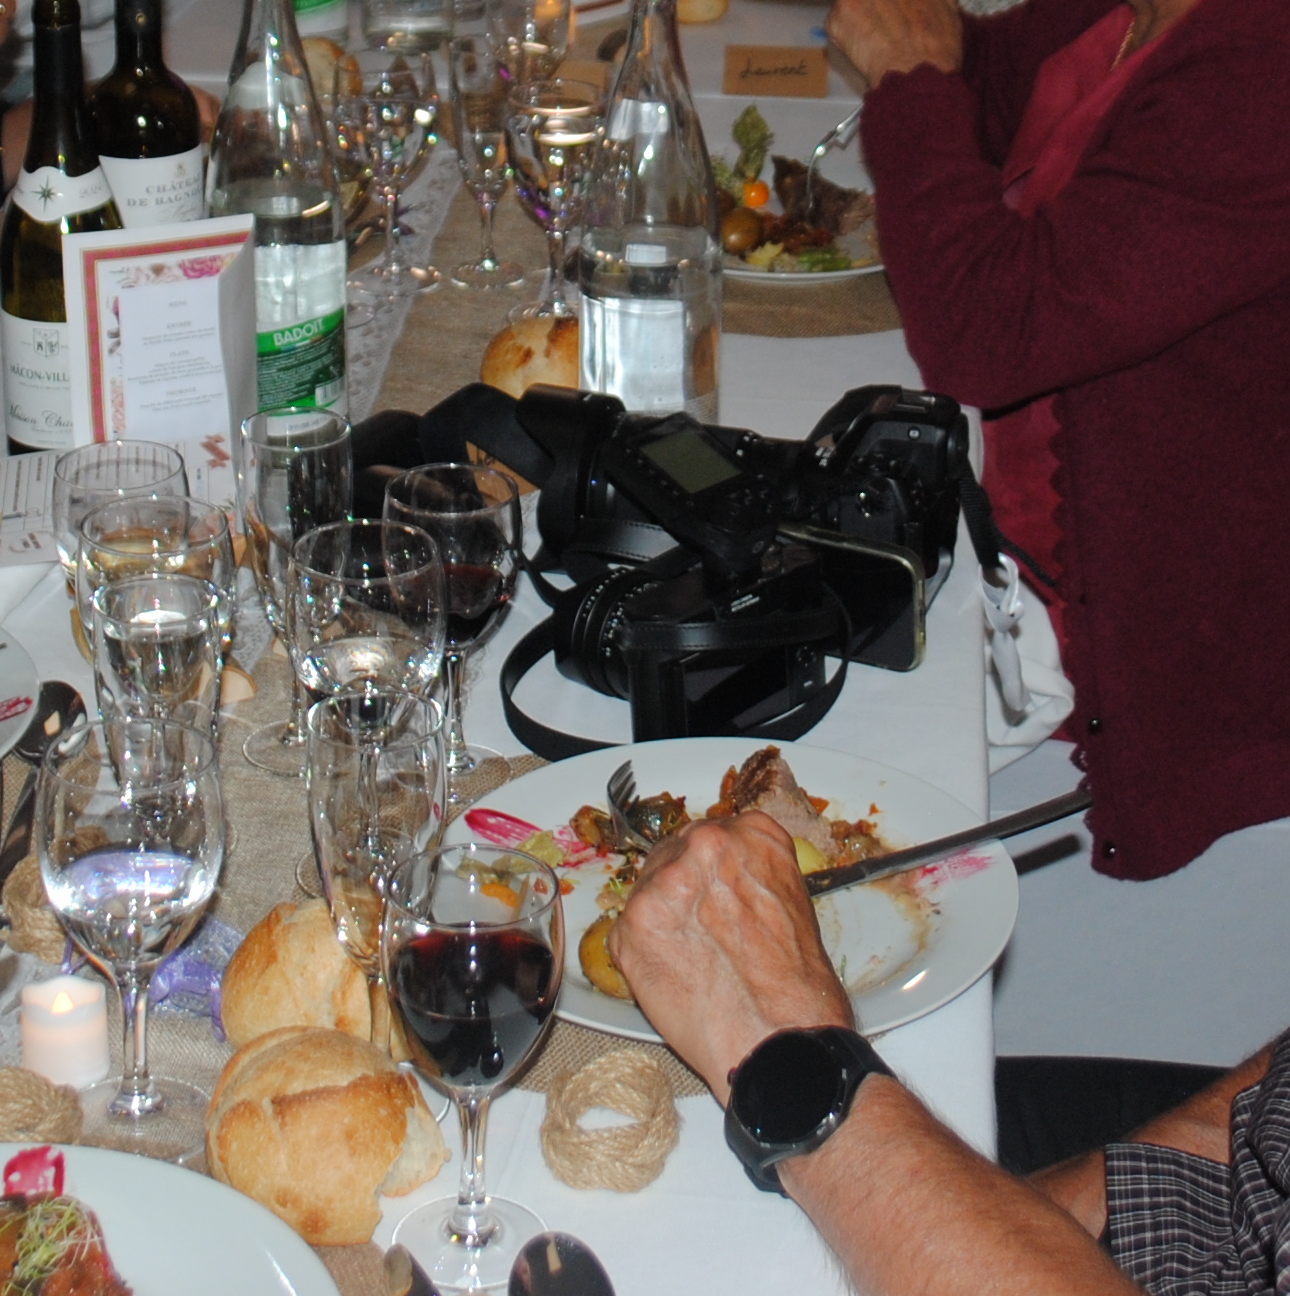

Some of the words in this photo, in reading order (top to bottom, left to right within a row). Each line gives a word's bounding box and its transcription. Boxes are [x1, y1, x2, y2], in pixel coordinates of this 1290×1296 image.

[126, 198, 149, 207] DE
[273, 317, 325, 346] BADOIT
[10, 363, 71, 383] MÂCON-VILL
